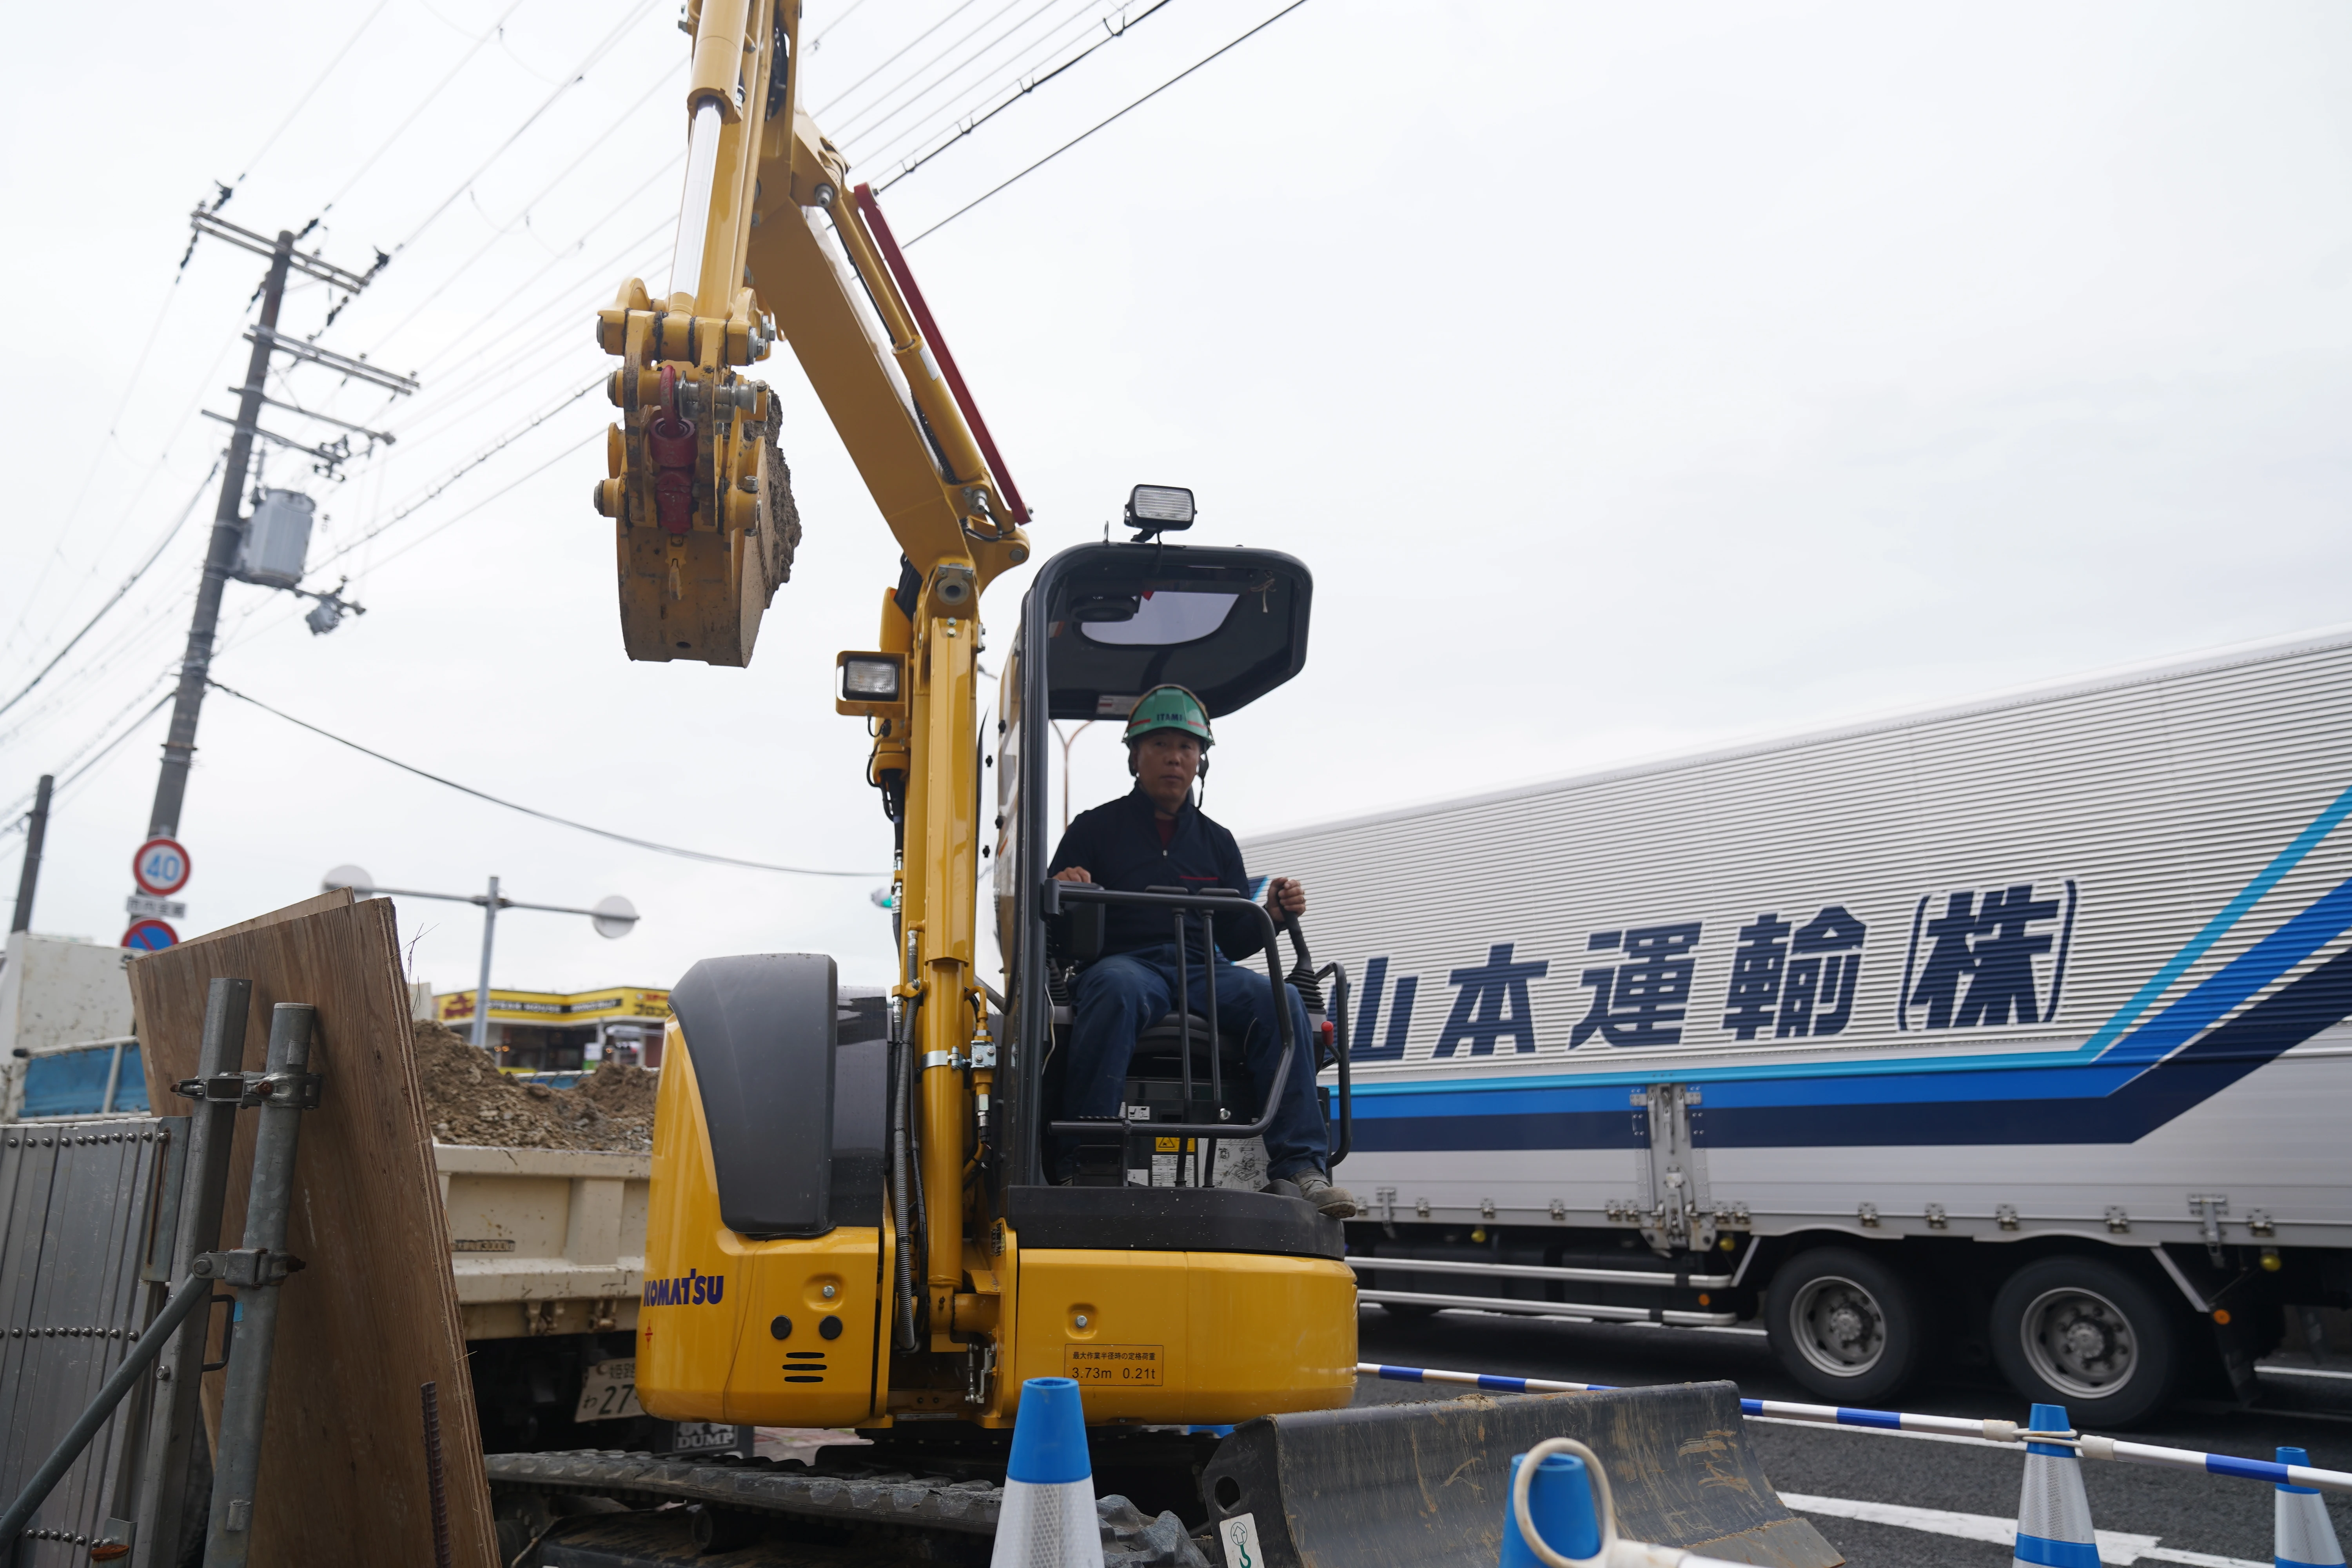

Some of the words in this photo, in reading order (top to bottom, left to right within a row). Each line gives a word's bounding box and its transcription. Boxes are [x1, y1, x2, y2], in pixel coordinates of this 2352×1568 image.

[146, 855, 180, 881] 40
[643, 1268, 724, 1307] KOMATSU
[1073, 1351, 1156, 1360] 最大作業半径時の定格荷重
[1072, 1367, 1111, 1379] 3.73m
[1123, 1368, 1156, 1379] 0.21t
[677, 1432, 734, 1448] DUMP
